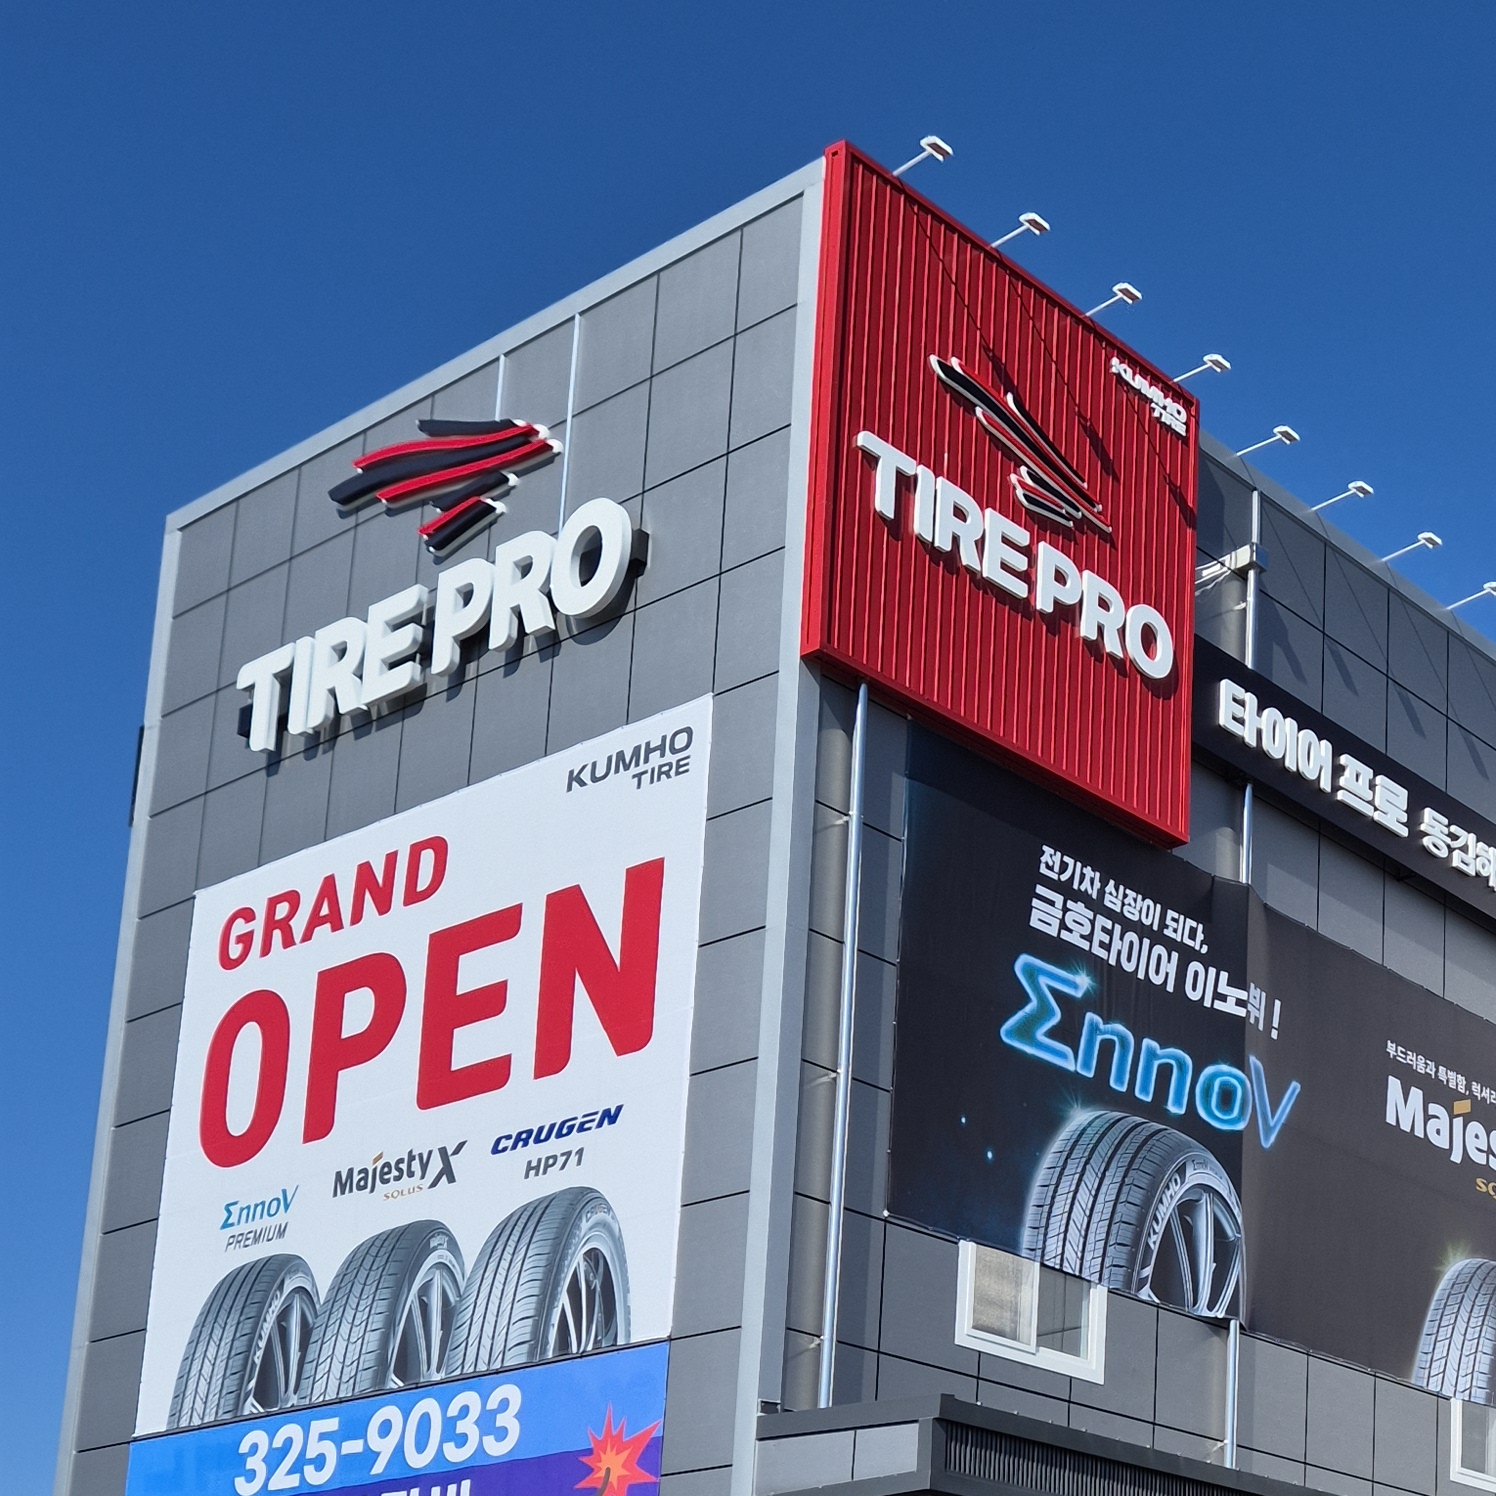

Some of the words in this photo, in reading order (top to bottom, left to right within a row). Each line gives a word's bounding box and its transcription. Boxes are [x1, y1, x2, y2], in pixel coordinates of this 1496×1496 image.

[566, 725, 693, 793] KUMHO
[632, 759, 691, 790] TIRE
[1218, 677, 1333, 794] 타이어
[1337, 751, 1409, 837] 프로
[218, 835, 449, 971] GRAND
[1038, 844, 1101, 900] 전기차
[1103, 878, 1160, 932] 심장이
[1164, 907, 1208, 955] 되다,
[1029, 883, 1181, 994] 금호타이어
[199, 857, 665, 1168] OPEN
[1386, 1039, 1437, 1079] 부드러움과
[1437, 1064, 1469, 1096] 특별함,
[490, 1104, 624, 1156] CRUGEN
[523, 1146, 584, 1180] HP71
[382, 1183, 424, 1201] SOLUS
[224, 1221, 289, 1252] PREMIUM
[234, 1384, 522, 1496] 325-9033
